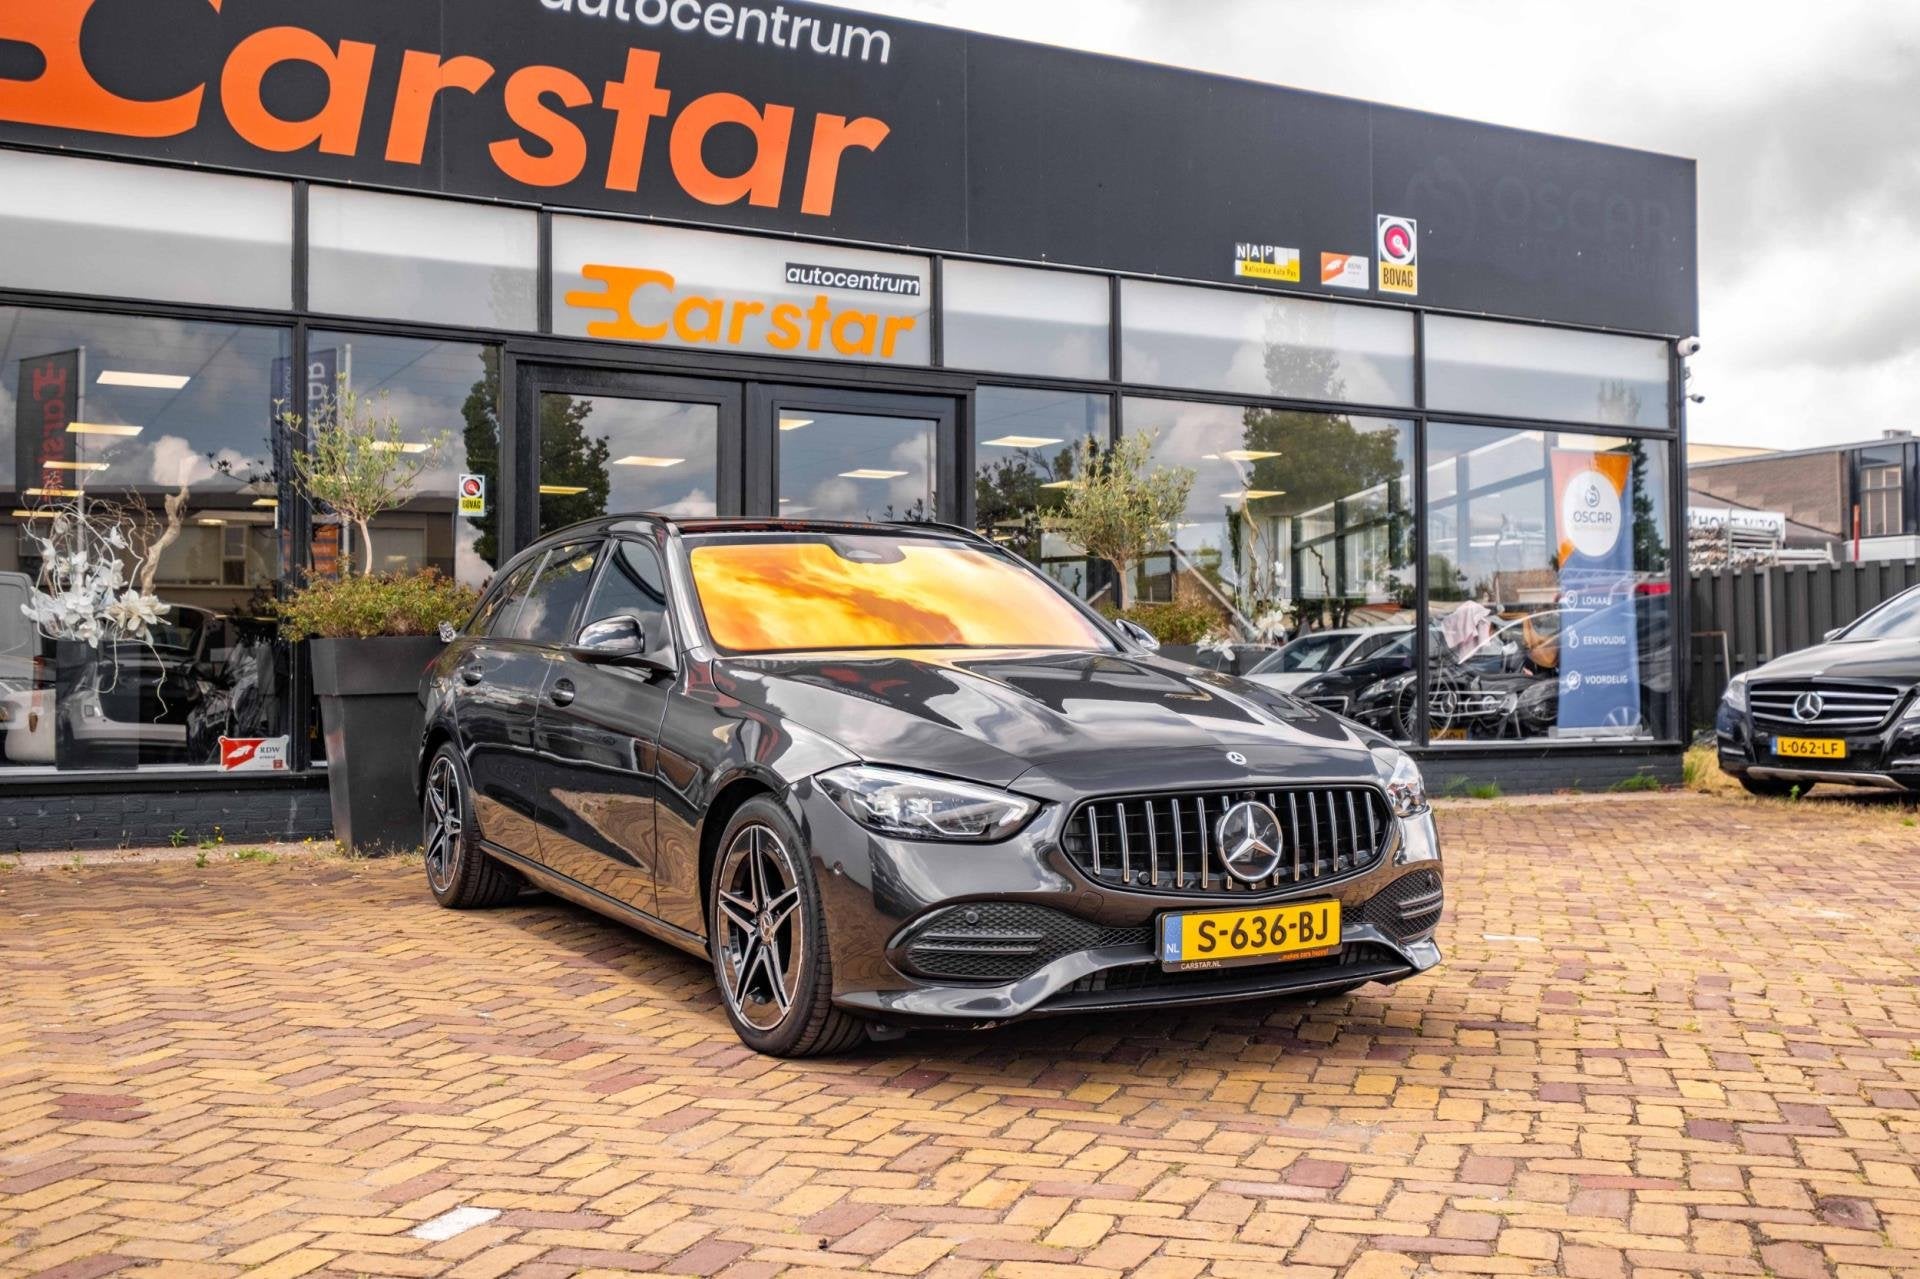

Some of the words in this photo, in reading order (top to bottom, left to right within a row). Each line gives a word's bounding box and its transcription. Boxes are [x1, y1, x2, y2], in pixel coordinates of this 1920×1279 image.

[539, 0, 892, 64] ocentrum
[1244, 264, 1271, 275] Nationale
[1273, 267, 1285, 275] Auto
[786, 265, 920, 294] autocentrum
[1383, 267, 1413, 288] BOVAG
[564, 263, 917, 358] Carstar
[1573, 510, 1613, 523] OSCAR
[1583, 635, 1627, 645] EENVOUDIG
[1584, 674, 1629, 684] VOORDELIG
[260, 746, 281, 754] RDW
[1781, 741, 1839, 755] L-062-LF
[1197, 908, 1329, 953] S-636-BJ
[1166, 943, 1180, 954] NL
[1180, 961, 1222, 970] CARSTAR.NL
